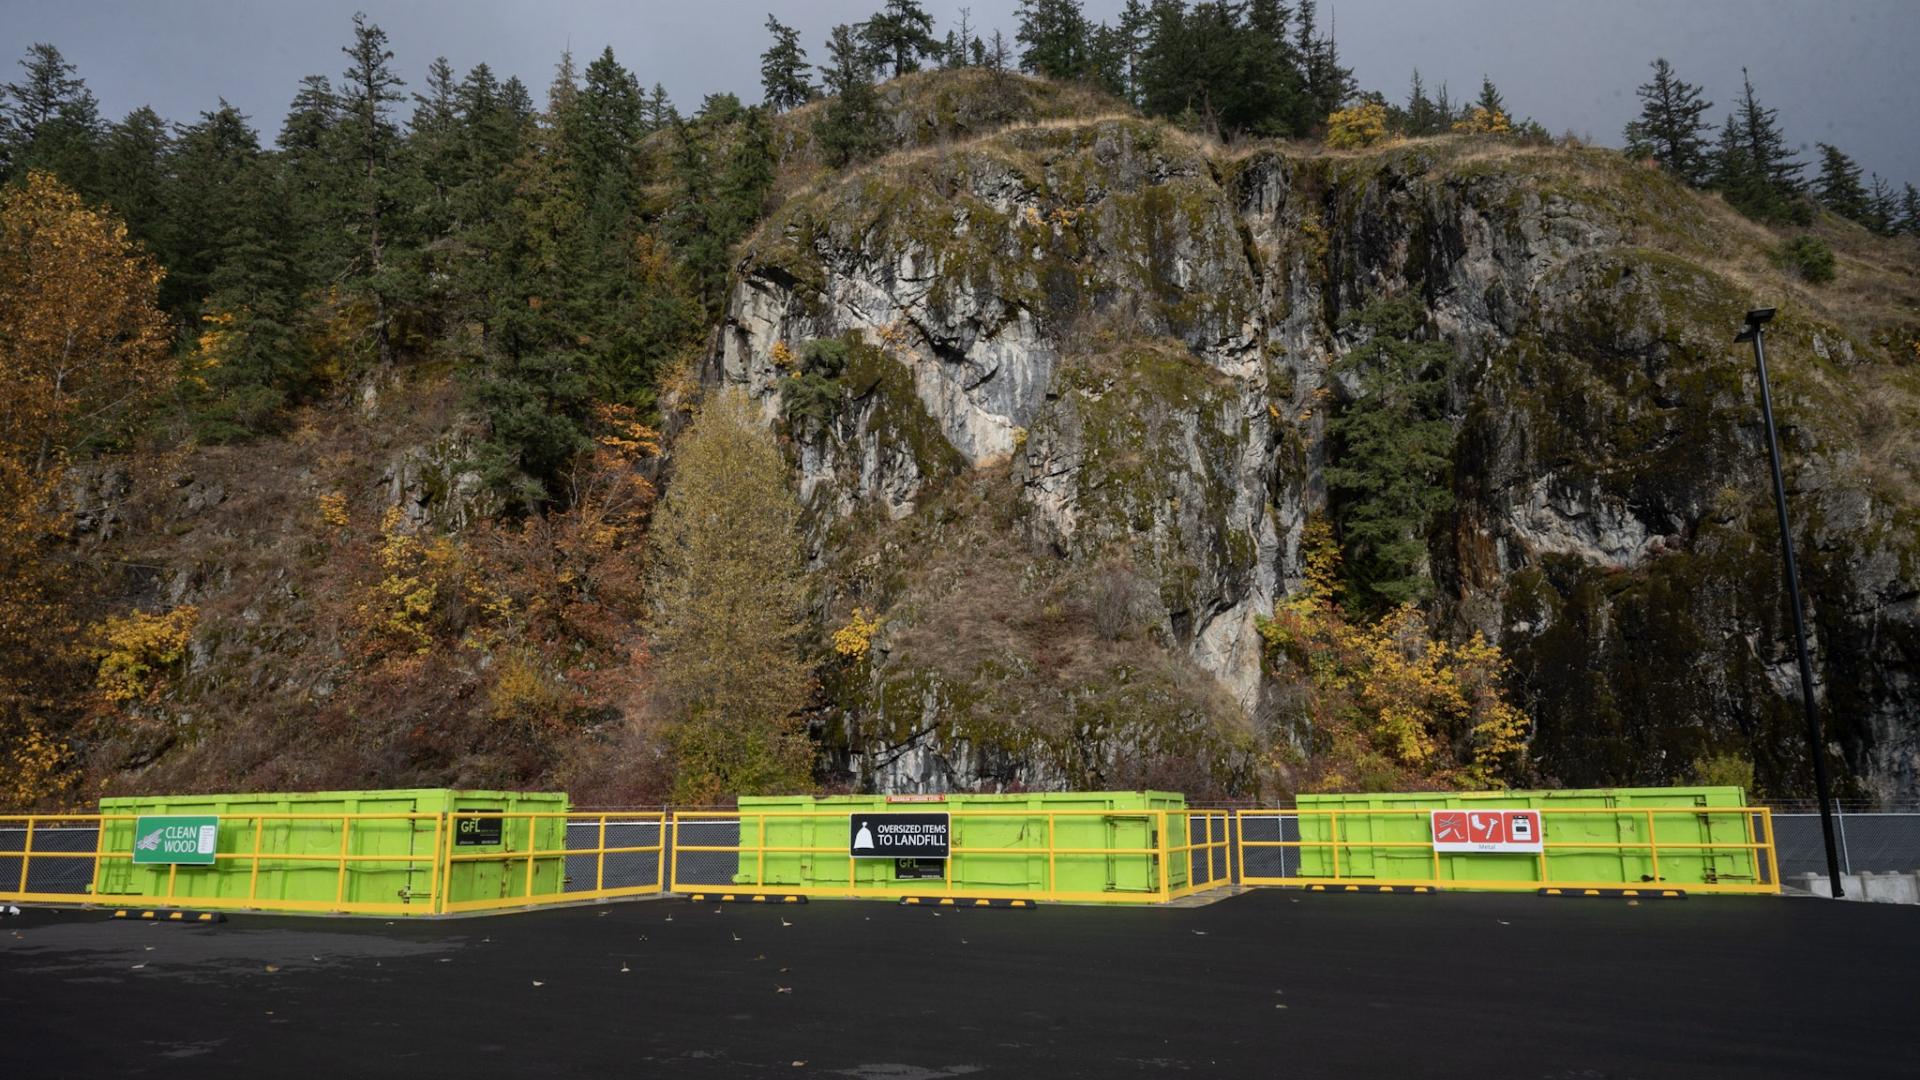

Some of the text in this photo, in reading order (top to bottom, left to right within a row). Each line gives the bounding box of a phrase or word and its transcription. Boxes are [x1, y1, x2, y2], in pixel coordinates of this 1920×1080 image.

[461, 819, 480, 833] GFL
[877, 824, 947, 834] OVERSIZED ITEMS
[165, 826, 197, 839] CLEAN
[877, 834, 946, 846] TO LANDFILL
[164, 840, 197, 853] WOOD
[899, 858, 919, 868] GFL
